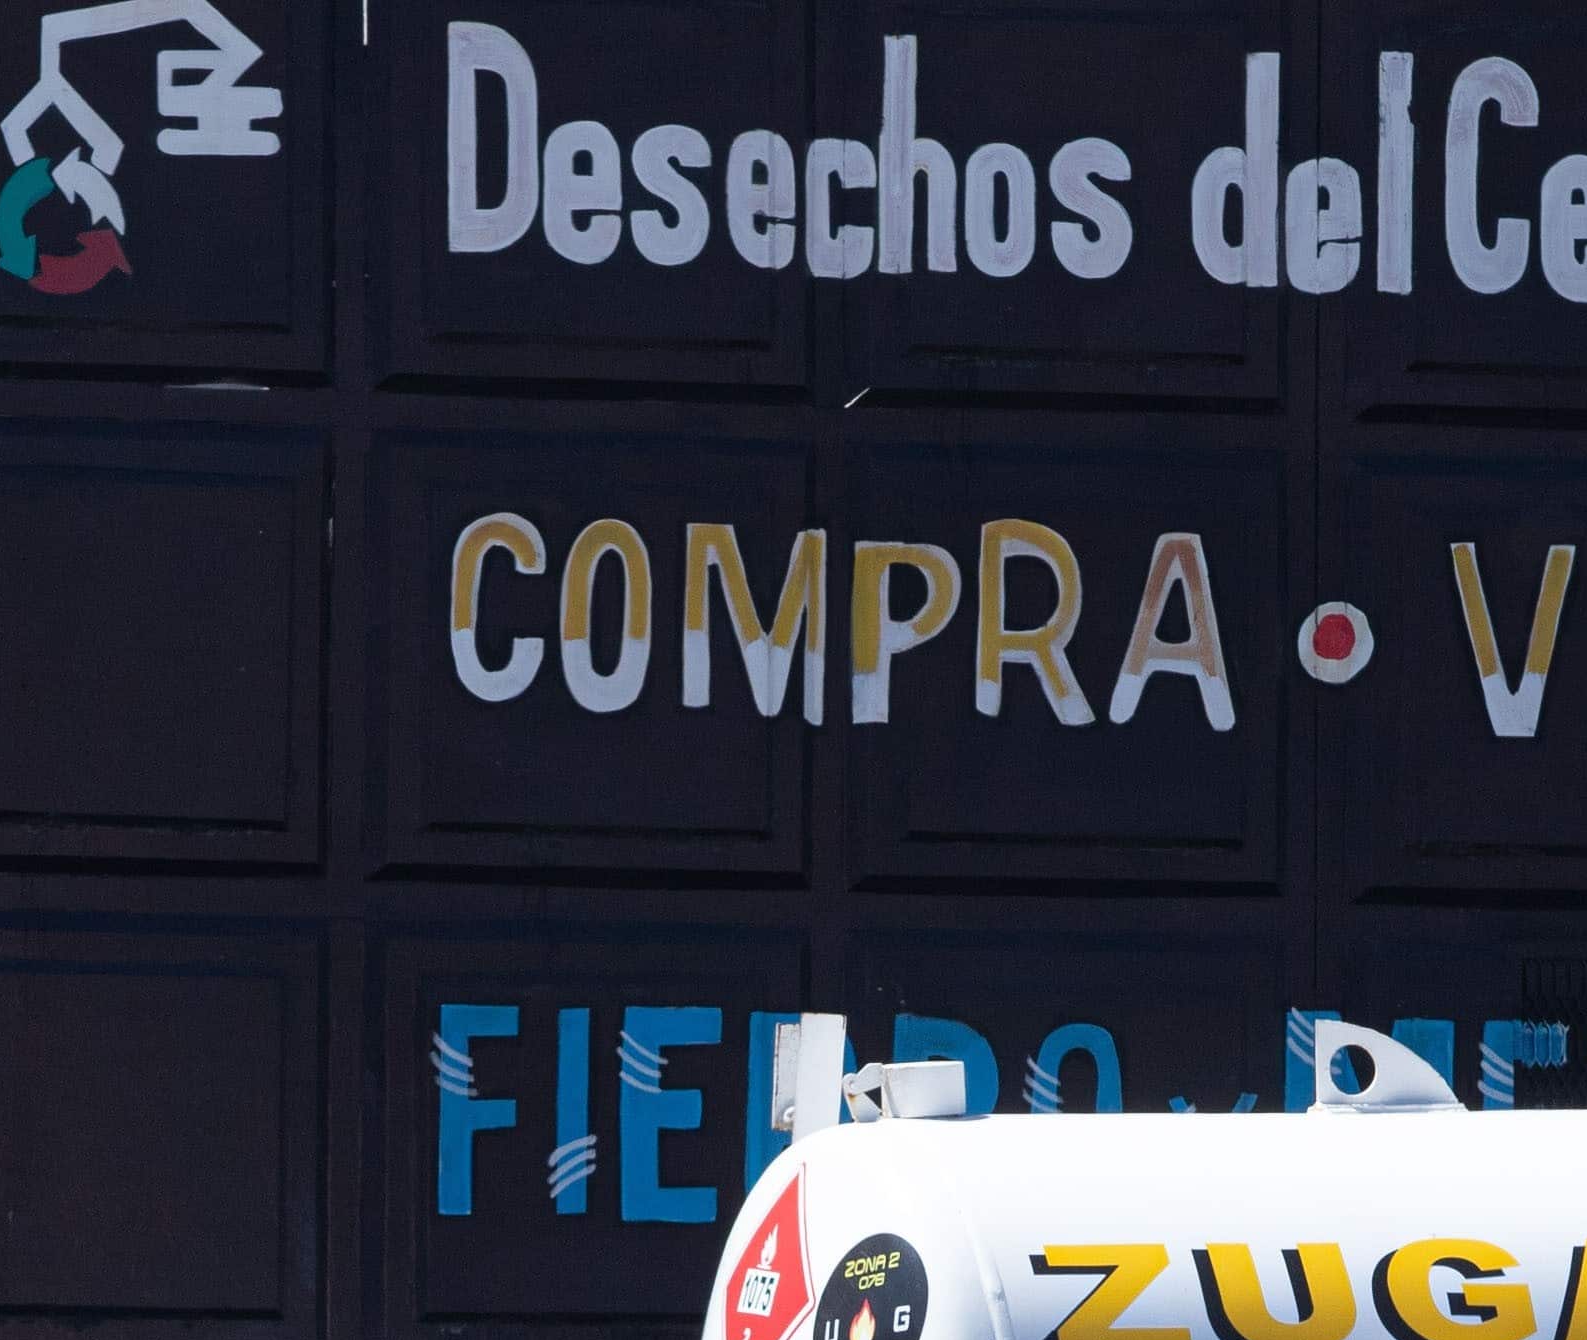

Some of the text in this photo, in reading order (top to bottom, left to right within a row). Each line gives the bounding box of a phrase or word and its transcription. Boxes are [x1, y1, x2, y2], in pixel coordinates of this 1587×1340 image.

[448, 21, 1131, 279] Desechos
[1192, 49, 1414, 295] del
[451, 512, 1236, 731] COMPRA
[844, 1254, 887, 1278] ZONA
[741, 1272, 775, 1312] 1075
[892, 1304, 911, 1333] G
